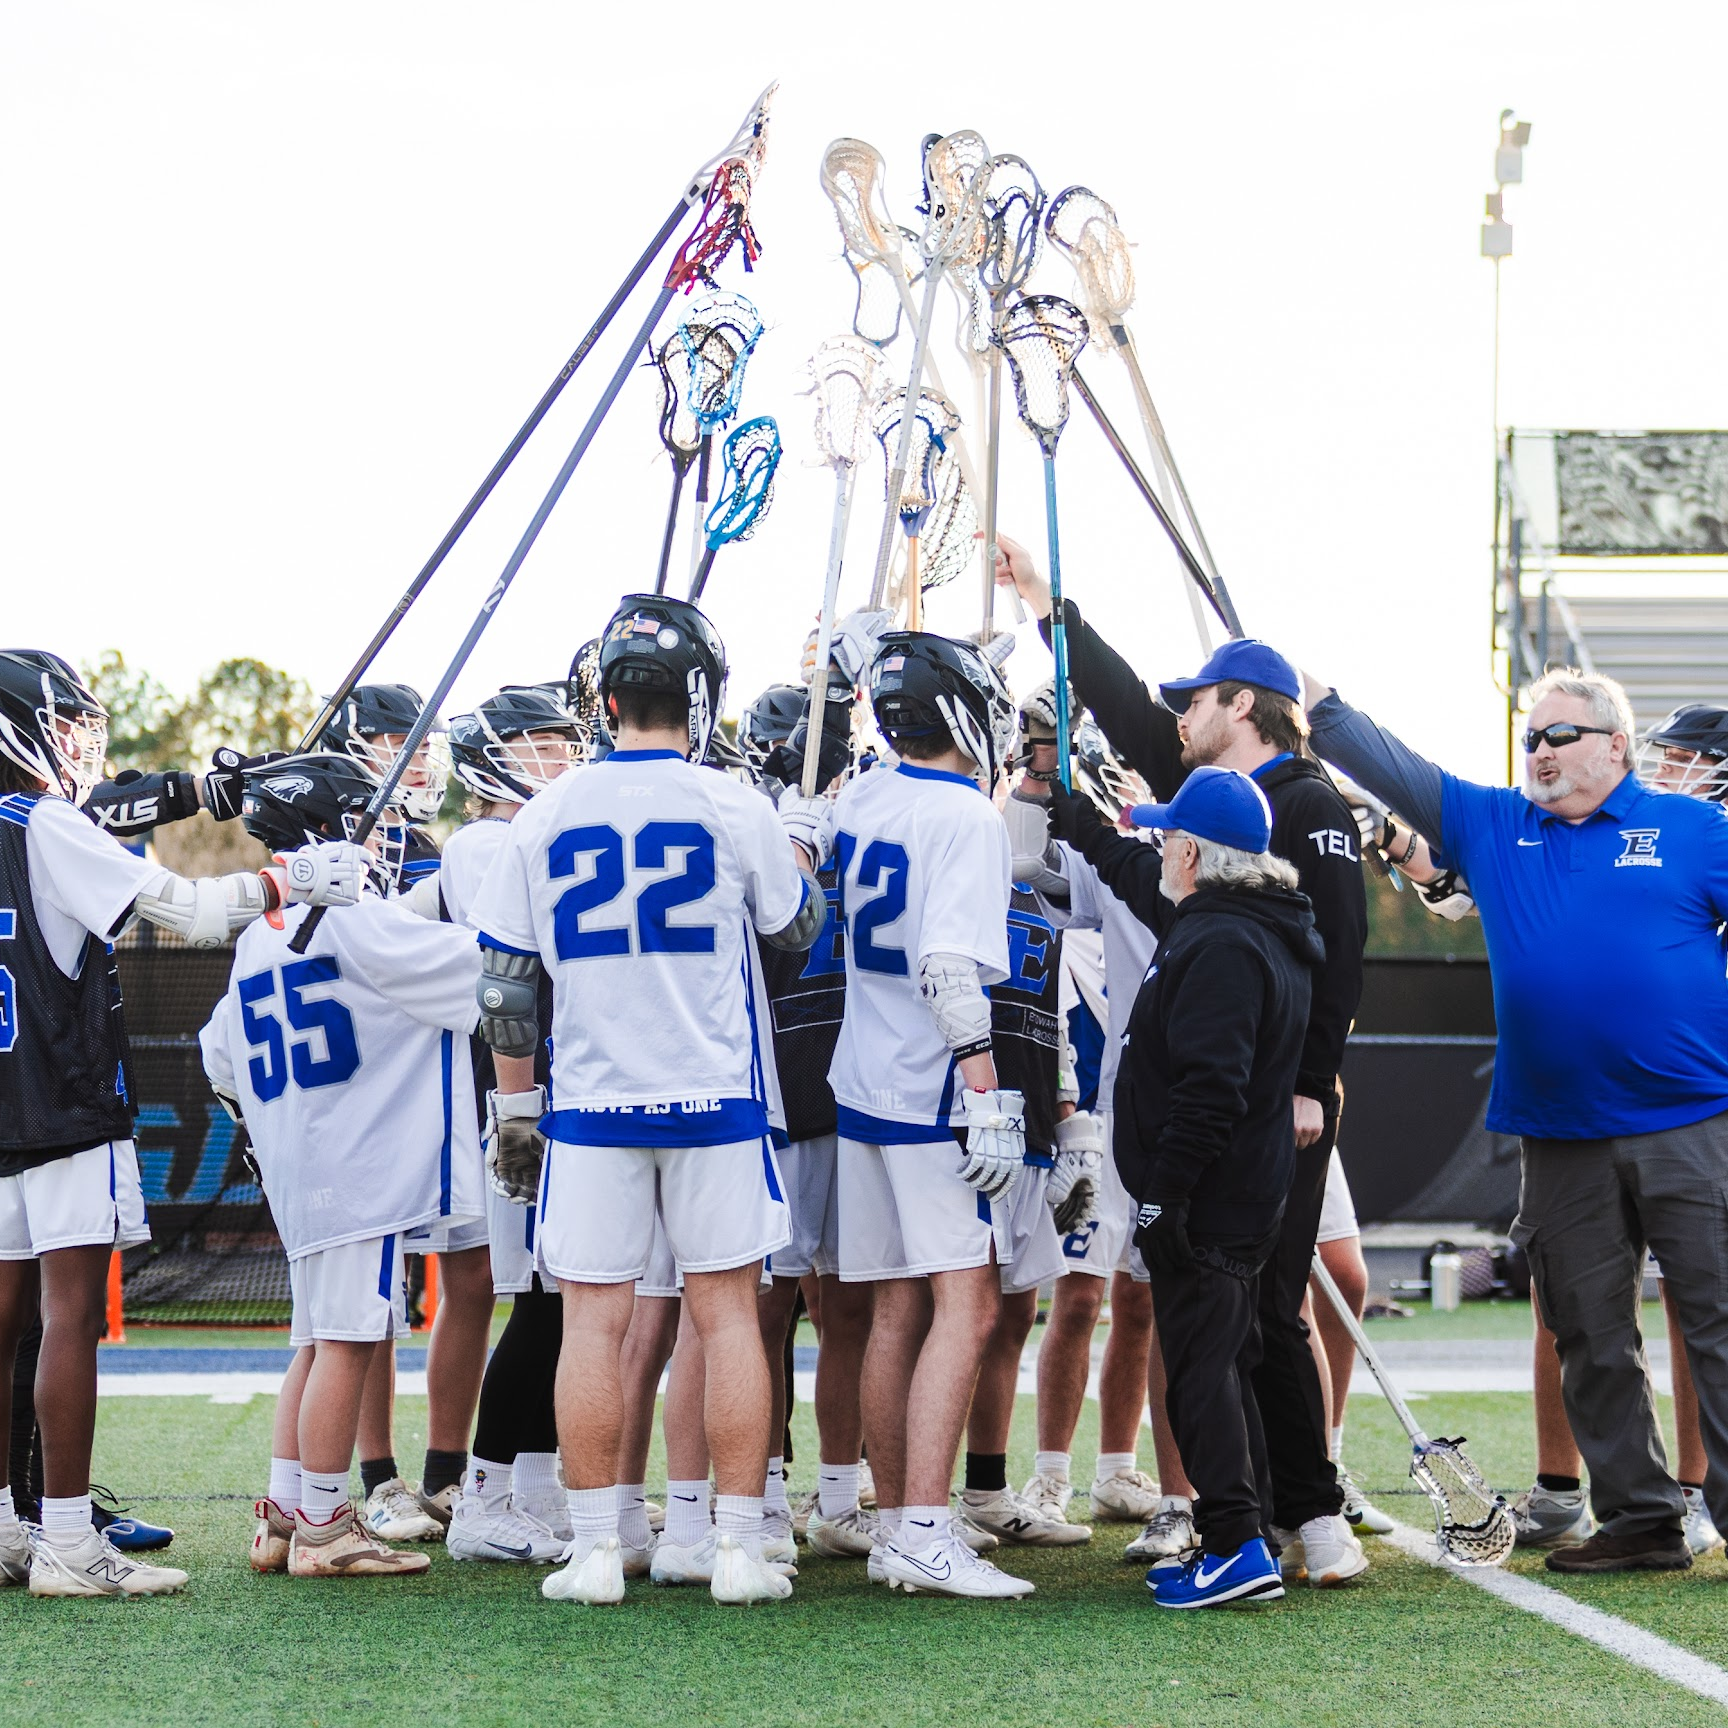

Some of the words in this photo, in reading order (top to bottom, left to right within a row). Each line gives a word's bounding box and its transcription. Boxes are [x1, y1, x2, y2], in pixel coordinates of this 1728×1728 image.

[560, 328, 600, 380] CALIBER
[610, 619, 635, 641] 22
[618, 785, 656, 797] STX
[92, 796, 160, 829] STX
[1308, 829, 1358, 863] TEL
[1618, 828, 1661, 859] E
[1614, 857, 1663, 868] LACROSSE
[547, 818, 719, 967] 22
[236, 952, 364, 1107] 55
